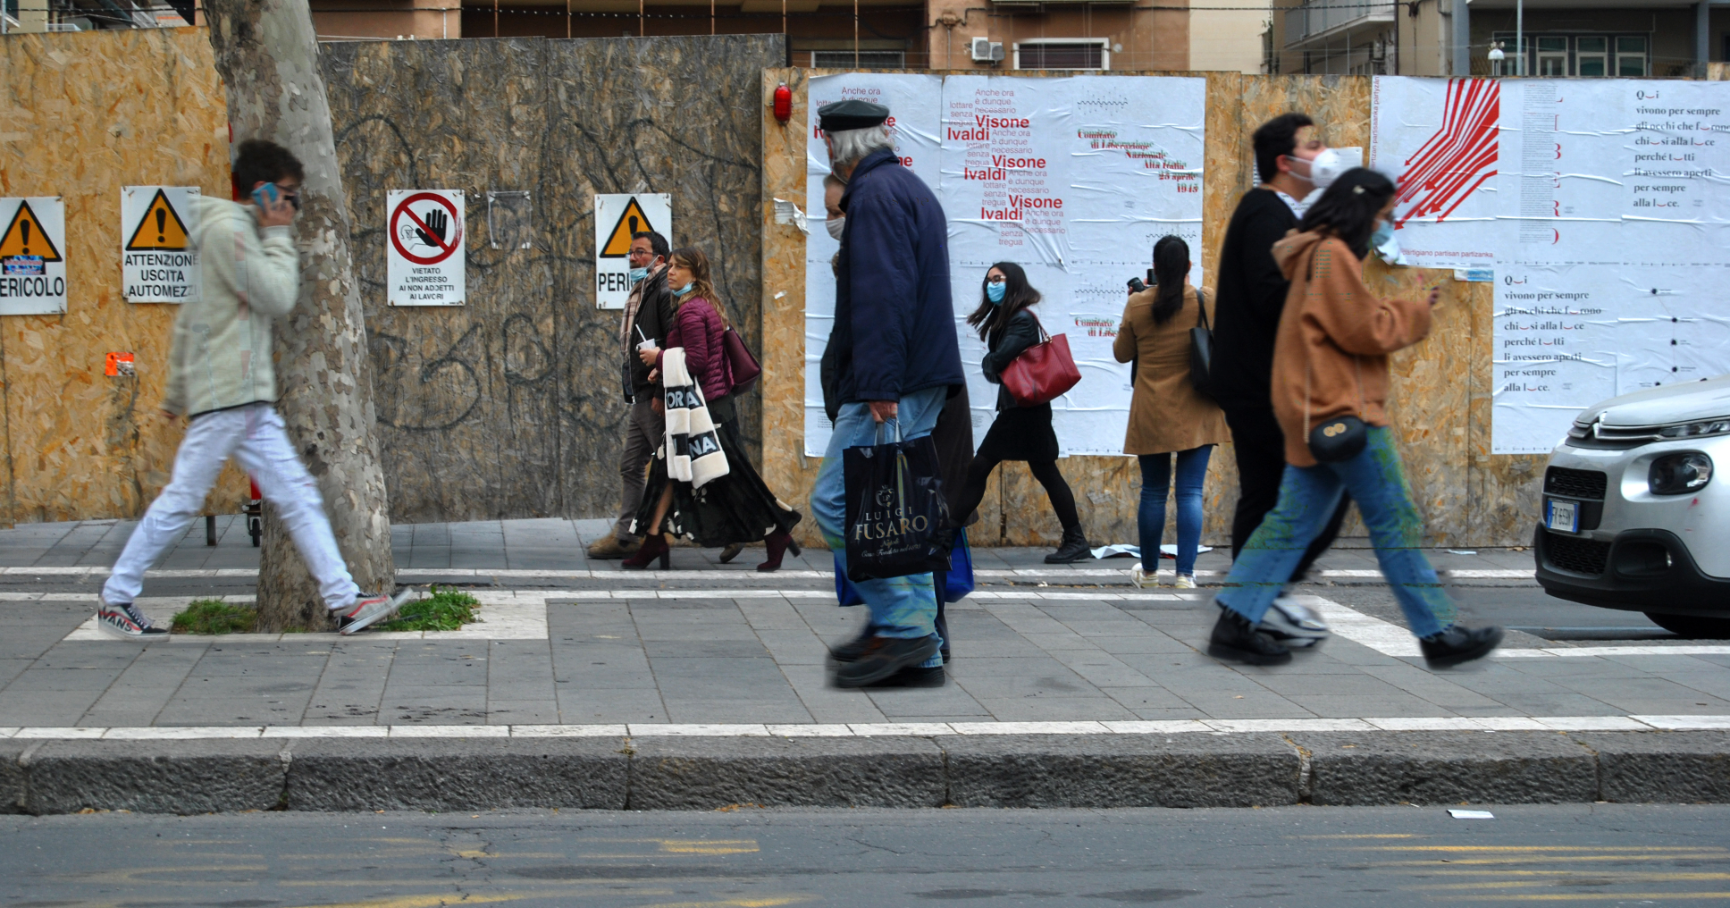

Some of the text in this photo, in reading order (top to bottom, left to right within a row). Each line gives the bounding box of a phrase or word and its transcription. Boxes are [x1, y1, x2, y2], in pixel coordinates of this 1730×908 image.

[841, 87, 866, 95] Anche
[982, 98, 1012, 106] dunque
[1636, 106, 1721, 117] vivono per sempre
[975, 114, 1030, 128] Visone
[1636, 121, 1648, 131] gli
[1649, 122, 1675, 130] occhi
[1677, 122, 1694, 130] che
[947, 127, 990, 141] Ivaldi
[1077, 129, 1117, 139] Comitato
[1091, 139, 1154, 150] di Liberazione
[1670, 137, 1688, 145] alla
[992, 155, 1046, 168] Visone
[1635, 152, 1667, 163] perché
[965, 159, 990, 167] tregua
[964, 167, 1006, 180] Ivaldi
[1634, 167, 1641, 176] li
[1683, 168, 1712, 178] aperti
[983, 181, 1007, 189] lottare
[1015, 178, 1044, 186] dunque
[1176, 183, 1199, 193] 1945
[1634, 185, 1686, 194] per sempre
[982, 199, 1006, 207] tregua
[1008, 194, 1063, 208] Visone
[1633, 198, 1651, 207] alla
[981, 207, 1023, 220] Ivaldi
[1025, 209, 1049, 217] Anche
[1032, 218, 1061, 226] dunque
[999, 239, 1023, 247] tregua
[125, 254, 199, 267] ATTENZIONE
[141, 269, 185, 282] USCITA
[1504, 291, 1589, 301] vivono per sempre
[1504, 307, 1516, 316] gli
[1518, 306, 1544, 314] occhi
[1546, 306, 1563, 315] che
[1540, 321, 1557, 330] alla
[1504, 337, 1536, 348] perché
[1504, 352, 1510, 361] li
[1553, 352, 1582, 362] aperti
[1504, 369, 1556, 378] per sempre
[1503, 383, 1521, 392] alla
[865, 506, 912, 521] LUIGI
[855, 514, 928, 540] FUSARO
[102, 605, 132, 632] VANS
